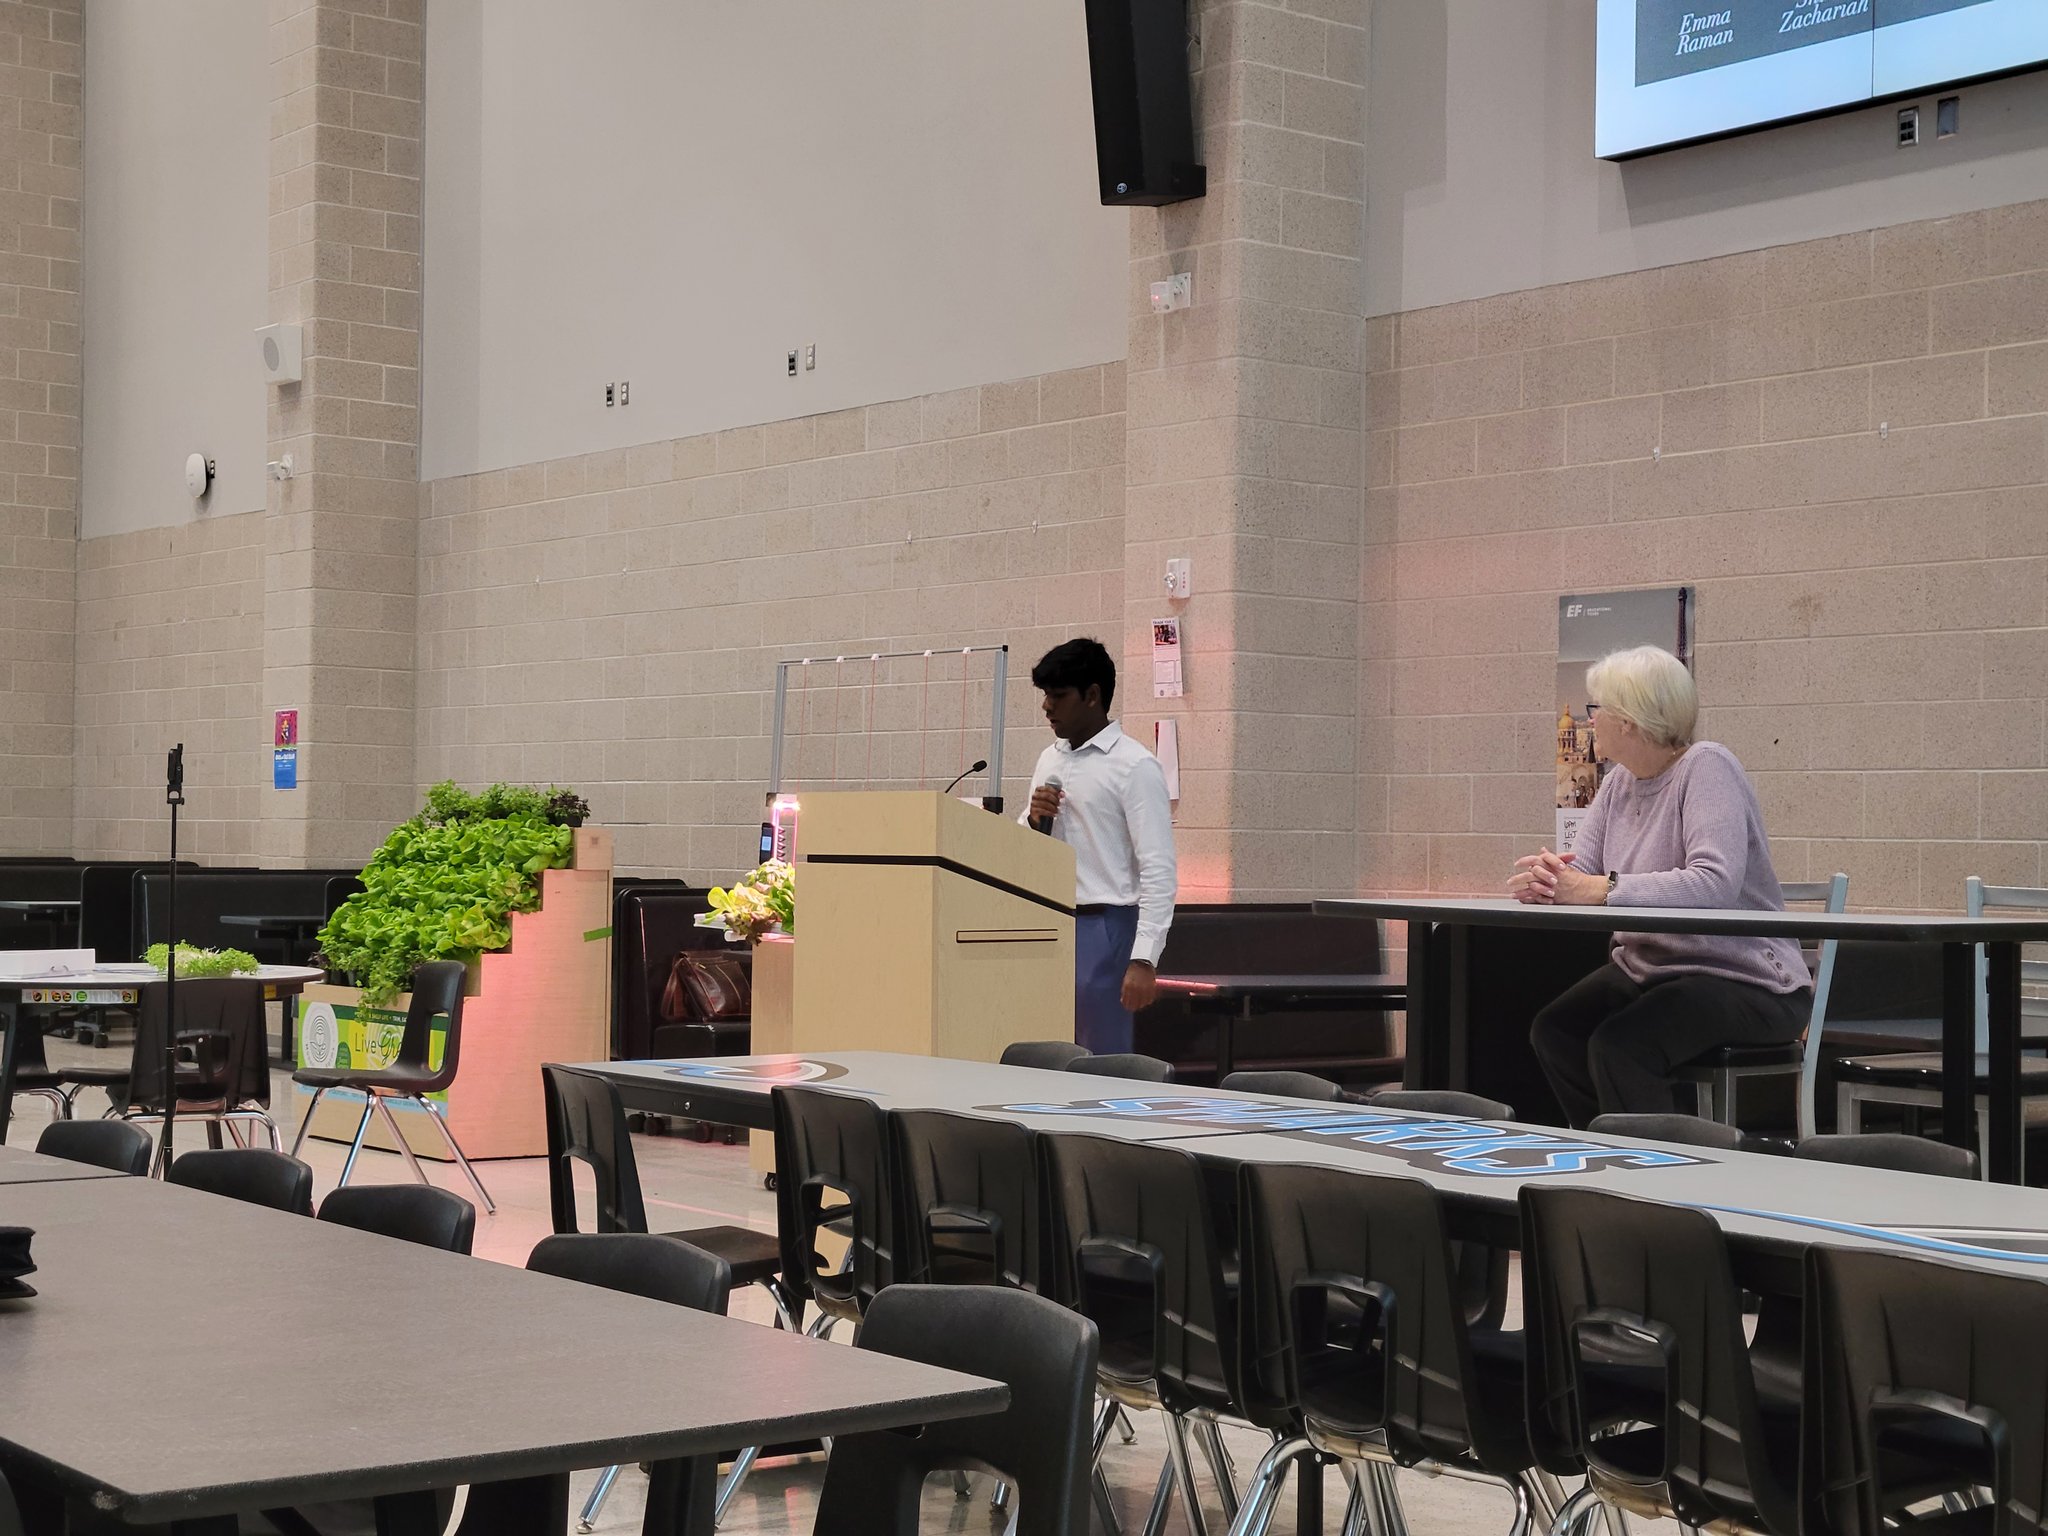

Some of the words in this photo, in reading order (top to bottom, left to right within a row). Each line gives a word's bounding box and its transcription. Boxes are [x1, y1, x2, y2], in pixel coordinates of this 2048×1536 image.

[1678, 10, 1731, 35] Emma
[1675, 29, 1734, 56] Raman
[1566, 604, 1583, 618] EF
[355, 1032, 377, 1054] Live
[1002, 1096, 1701, 1175] SHARKS
